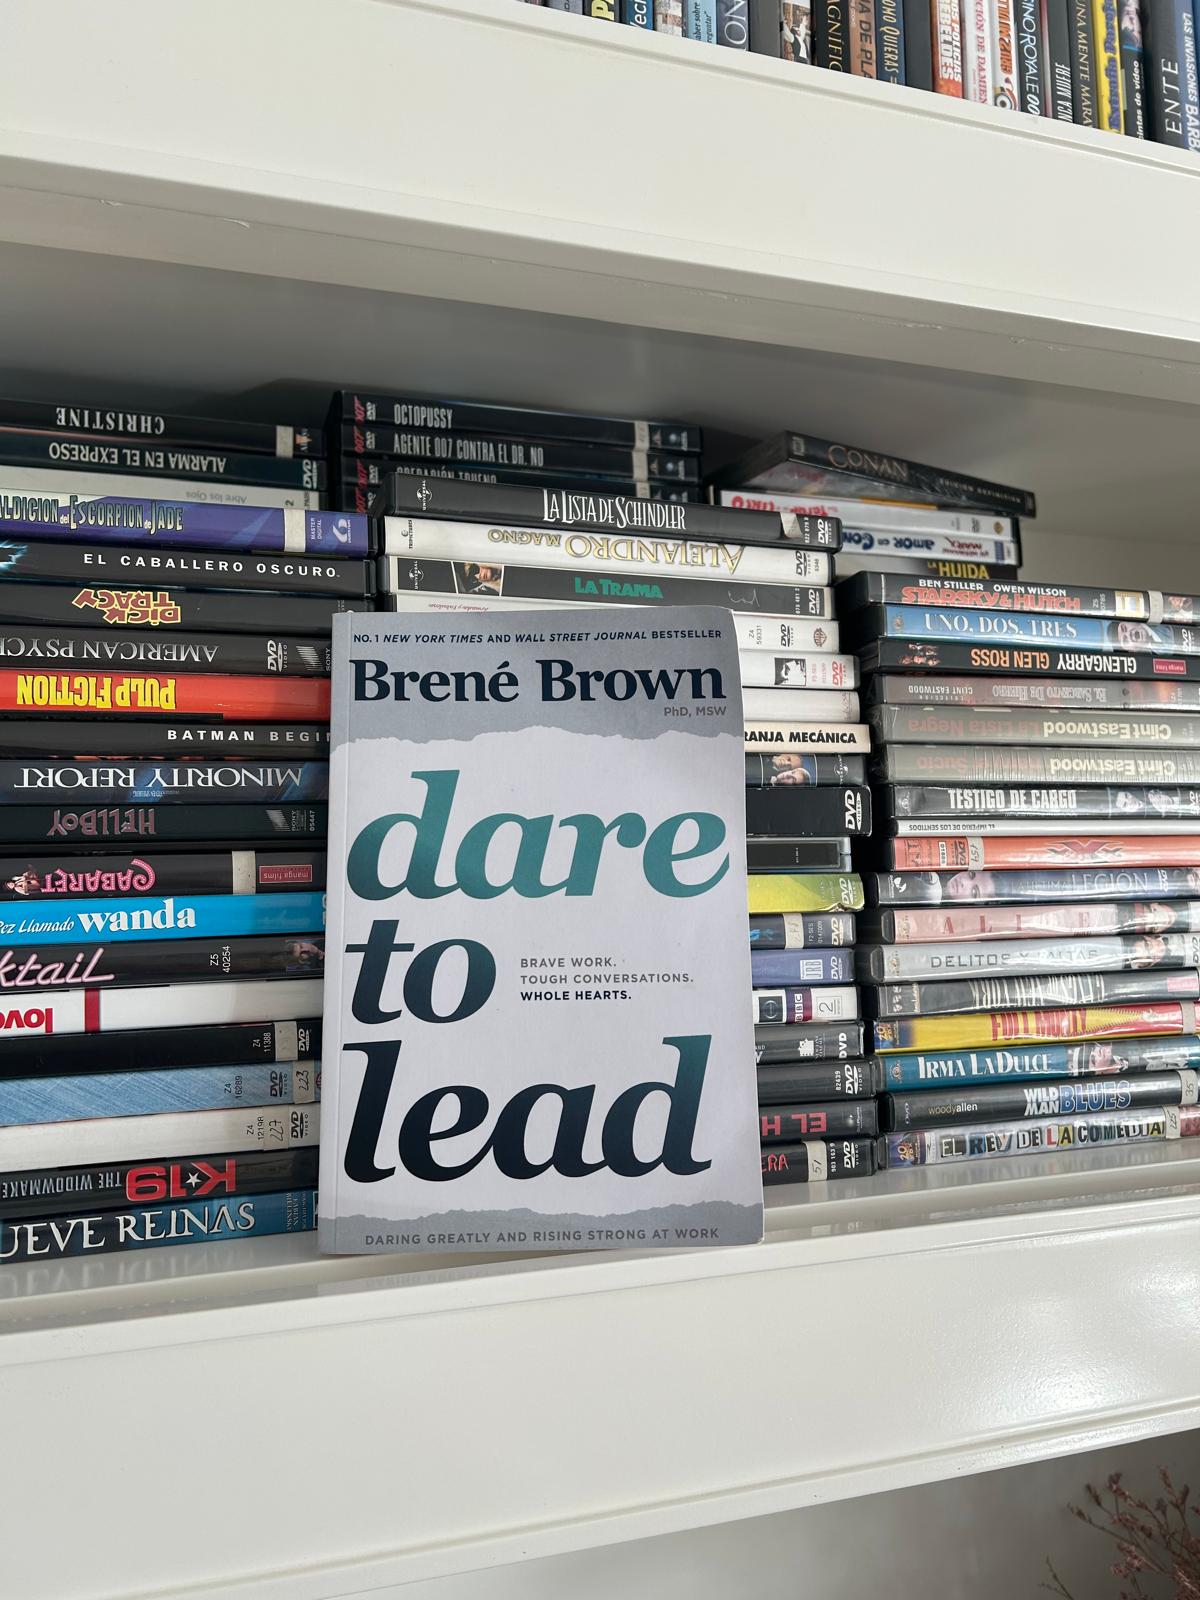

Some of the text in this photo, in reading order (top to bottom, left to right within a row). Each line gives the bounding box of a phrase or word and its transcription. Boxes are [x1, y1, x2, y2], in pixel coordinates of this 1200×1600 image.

[880, 26, 899, 74] QUIERAS
[1020, 33, 1039, 92] ROYALE
[1077, 32, 1090, 82] MENTE
[1134, 94, 1142, 106] de
[56, 407, 165, 436] CHRISTINE
[393, 403, 453, 429] OCTOPUSSY
[48, 442, 227, 474] ALARMA EN EL EXPRESO
[393, 433, 545, 468] AGENTE 007 CONTRA EL DR. NO
[828, 444, 909, 480] CONAN
[0, 494, 59, 523] LDICION
[151, 501, 184, 536] JADE
[561, 490, 597, 524] LISTA
[599, 498, 615, 524] DE
[615, 496, 687, 530] SCHINDLER
[817, 518, 825, 544] DVD
[487, 528, 746, 576] ALEJANDRO MAGNO
[84, 553, 337, 578] EL CABALLERO OSCURO
[938, 562, 990, 579] HUIDA
[72, 588, 176, 612] TRACY
[574, 576, 664, 599] LA TRAMA
[900, 586, 1081, 611] STARSKY HUTCH
[919, 578, 1067, 597] BEN STILLER OWEN WILSON
[808, 588, 816, 615] DVD
[353, 630, 722, 643] NO. 1 NEW YORK TIMES AND WALL STREET JOURNAL BESTSELLER
[780, 623, 788, 647] DVD
[1031, 620, 1077, 639] TRES
[83, 639, 221, 663] AMERICAN
[267, 639, 277, 672] DVD
[971, 648, 1138, 674] GLENGARRY GLEN ROSS
[17, 674, 177, 711] PULP FICTION
[349, 659, 728, 702] Brené Brown
[664, 706, 728, 718] PhD, MSW
[167, 729, 331, 742] BATMAN BEGI
[789, 729, 857, 744] MECÁNICA
[1043, 721, 1133, 739] Eastwood
[1132, 723, 1172, 739] Clint
[13, 767, 303, 789] MINORITY REPORT
[1050, 757, 1136, 775] Eastwood
[1137, 759, 1176, 776] Clint
[844, 789, 856, 830] DVD
[948, 789, 1077, 810] TESTIGO DE CARGO
[47, 808, 156, 837] HELLBOY
[346, 769, 731, 901] dare
[41, 857, 157, 893] CABARET
[18, 898, 197, 934] Llamado wanda
[830, 917, 839, 946] DVD
[210, 953, 219, 966] Z5
[222, 945, 231, 974] 40254
[344, 919, 497, 1024] to
[520, 957, 617, 968] BRAVE WORK.
[830, 956, 838, 980] DVD
[930, 954, 1010, 969] DELITOS
[520, 973, 695, 985] TOUGH CONVERSATIONS.
[520, 989, 632, 1001] WHOLE HEARTS.
[795, 993, 804, 1022] BBC
[298, 1028, 306, 1052] DVD
[838, 1032, 847, 1059] DVD
[917, 1050, 1052, 1080] IRMA LA DULCE
[269, 1070, 278, 1098] DVD
[844, 1064, 854, 1095] DVD
[341, 1034, 713, 1184] lead
[1023, 1080, 1132, 1113] WILD BLUES
[1023, 1101, 1060, 1117] MAN
[290, 1110, 299, 1139] DVD
[792, 1112, 827, 1133] EL
[940, 1120, 1165, 1159] EL REY DE LA COMEDIA
[843, 1141, 852, 1169] DVD
[98, 1171, 123, 1188] THE
[115, 1202, 257, 1243] REINAS
[364, 1227, 720, 1246] DARING GREATLY AND RISING STRONG AT WORK
